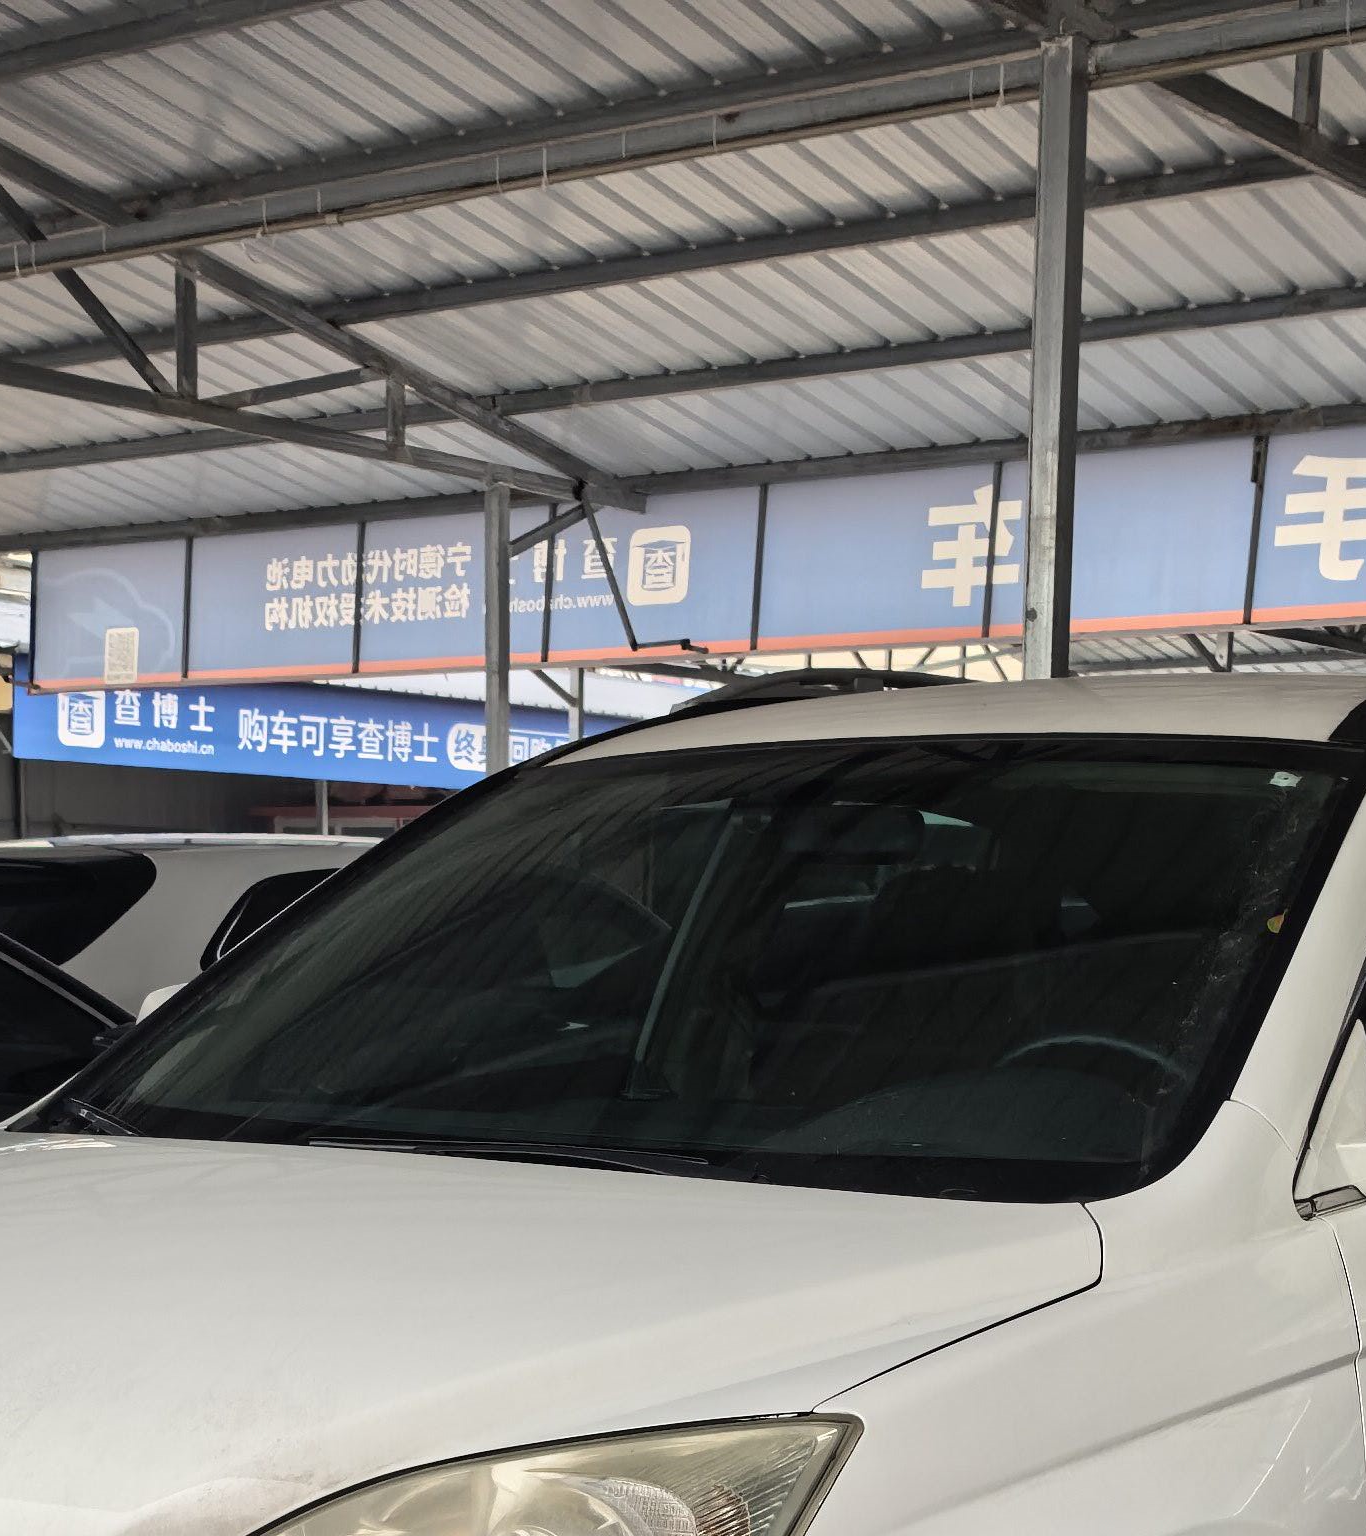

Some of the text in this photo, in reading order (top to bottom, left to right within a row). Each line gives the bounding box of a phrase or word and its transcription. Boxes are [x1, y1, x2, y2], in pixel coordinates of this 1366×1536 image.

[113, 689, 216, 732] 查博士
[237, 707, 439, 763] 购车可享查博士
[113, 736, 215, 756] www.chaboshi.cn
